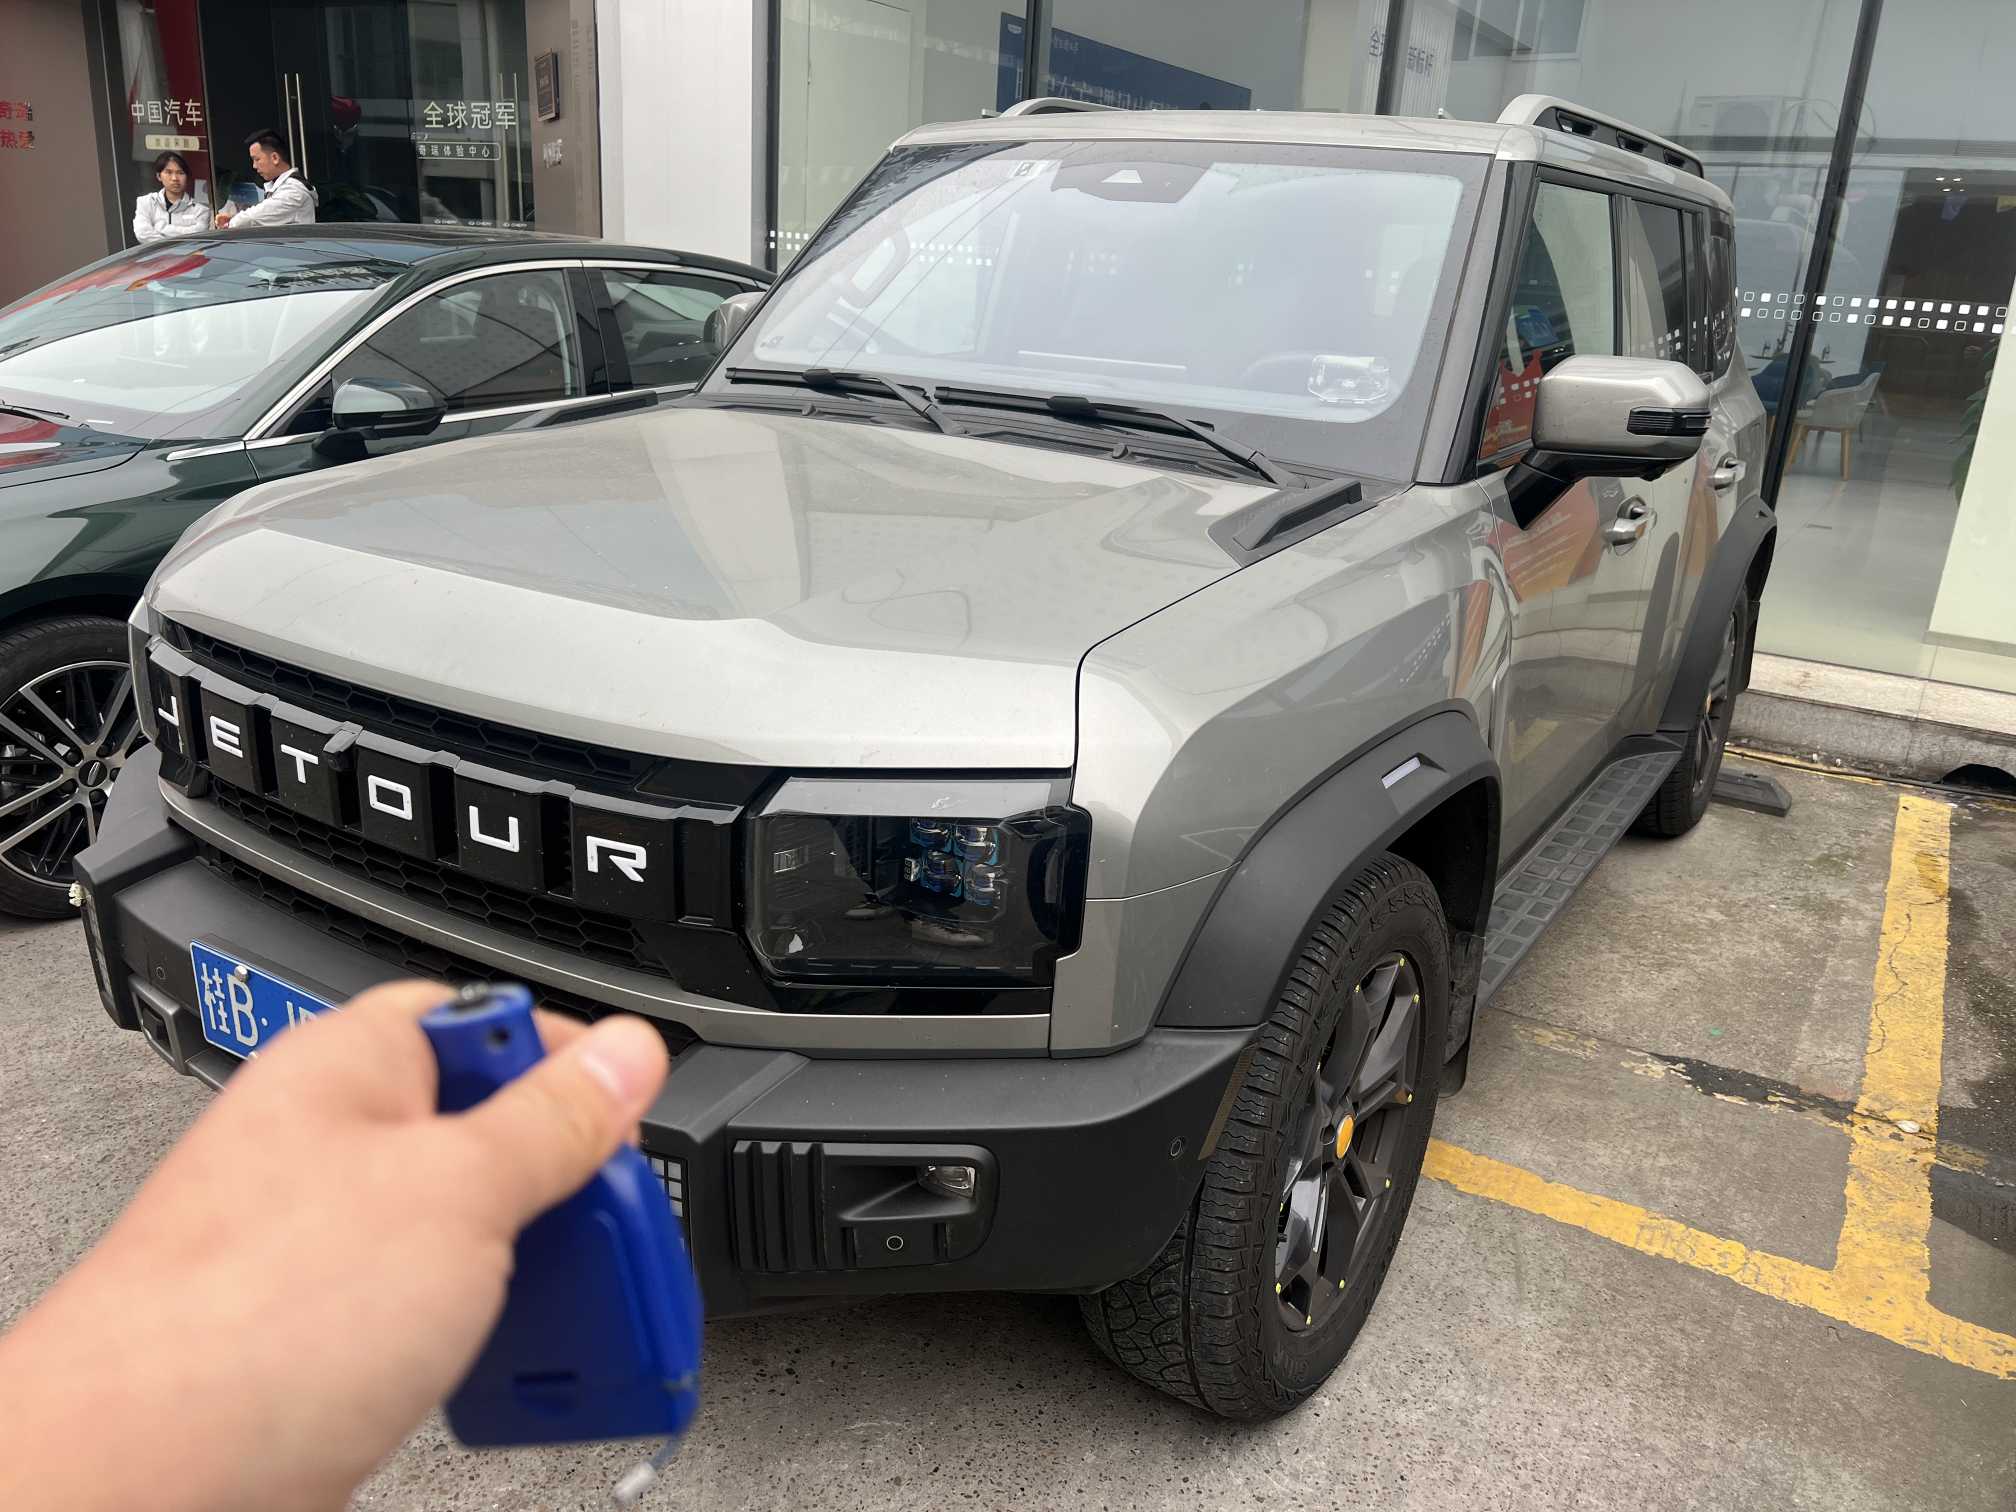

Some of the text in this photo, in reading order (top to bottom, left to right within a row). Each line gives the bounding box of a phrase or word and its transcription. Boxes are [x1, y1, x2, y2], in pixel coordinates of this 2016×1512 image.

[131, 98, 203, 127] 中国汽车
[423, 101, 516, 130] 全球冠军
[158, 695, 648, 883] JETOUR
